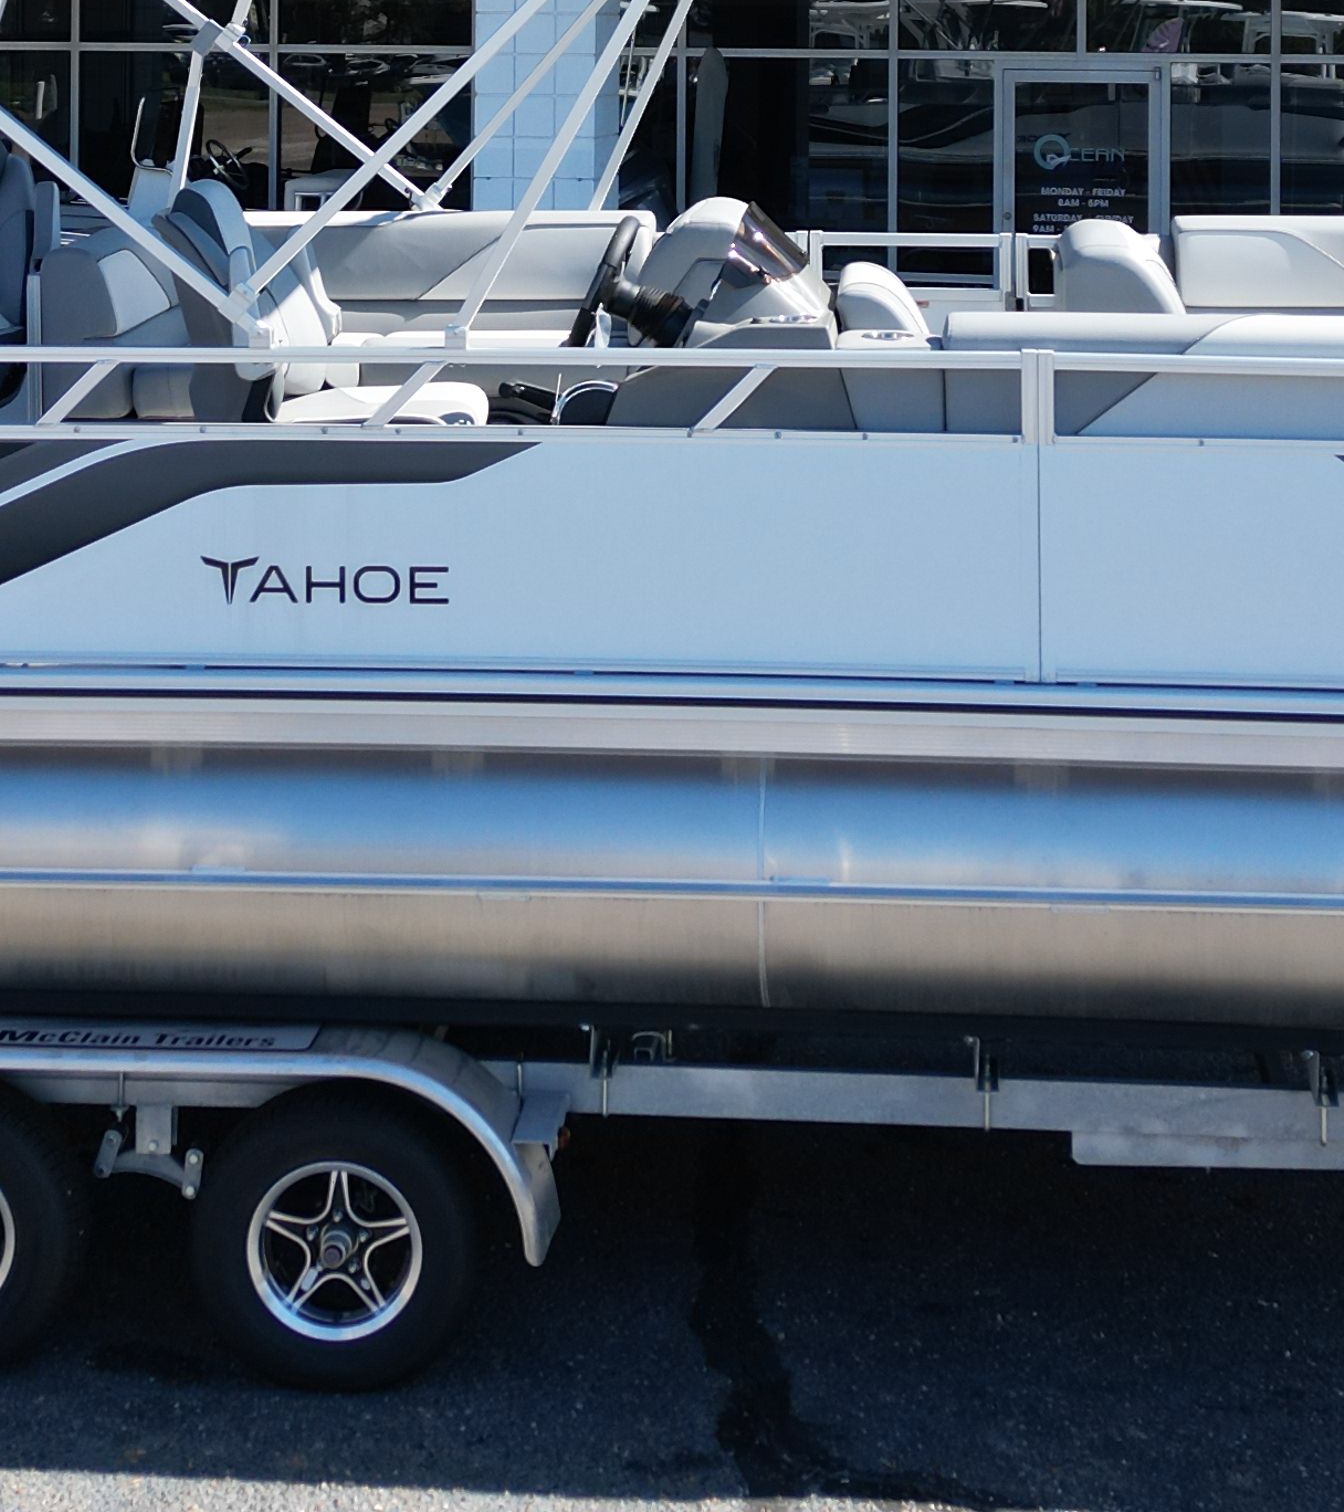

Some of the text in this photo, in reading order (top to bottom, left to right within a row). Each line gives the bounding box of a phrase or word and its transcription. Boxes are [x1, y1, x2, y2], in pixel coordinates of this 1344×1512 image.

[1033, 133, 1126, 170] OCEAN
[1040, 186, 1085, 196] MONDAY
[1091, 187, 1127, 197] FRIDAY
[199, 555, 450, 605] TAHOE
[154, 1031, 276, 1048] Trailers
